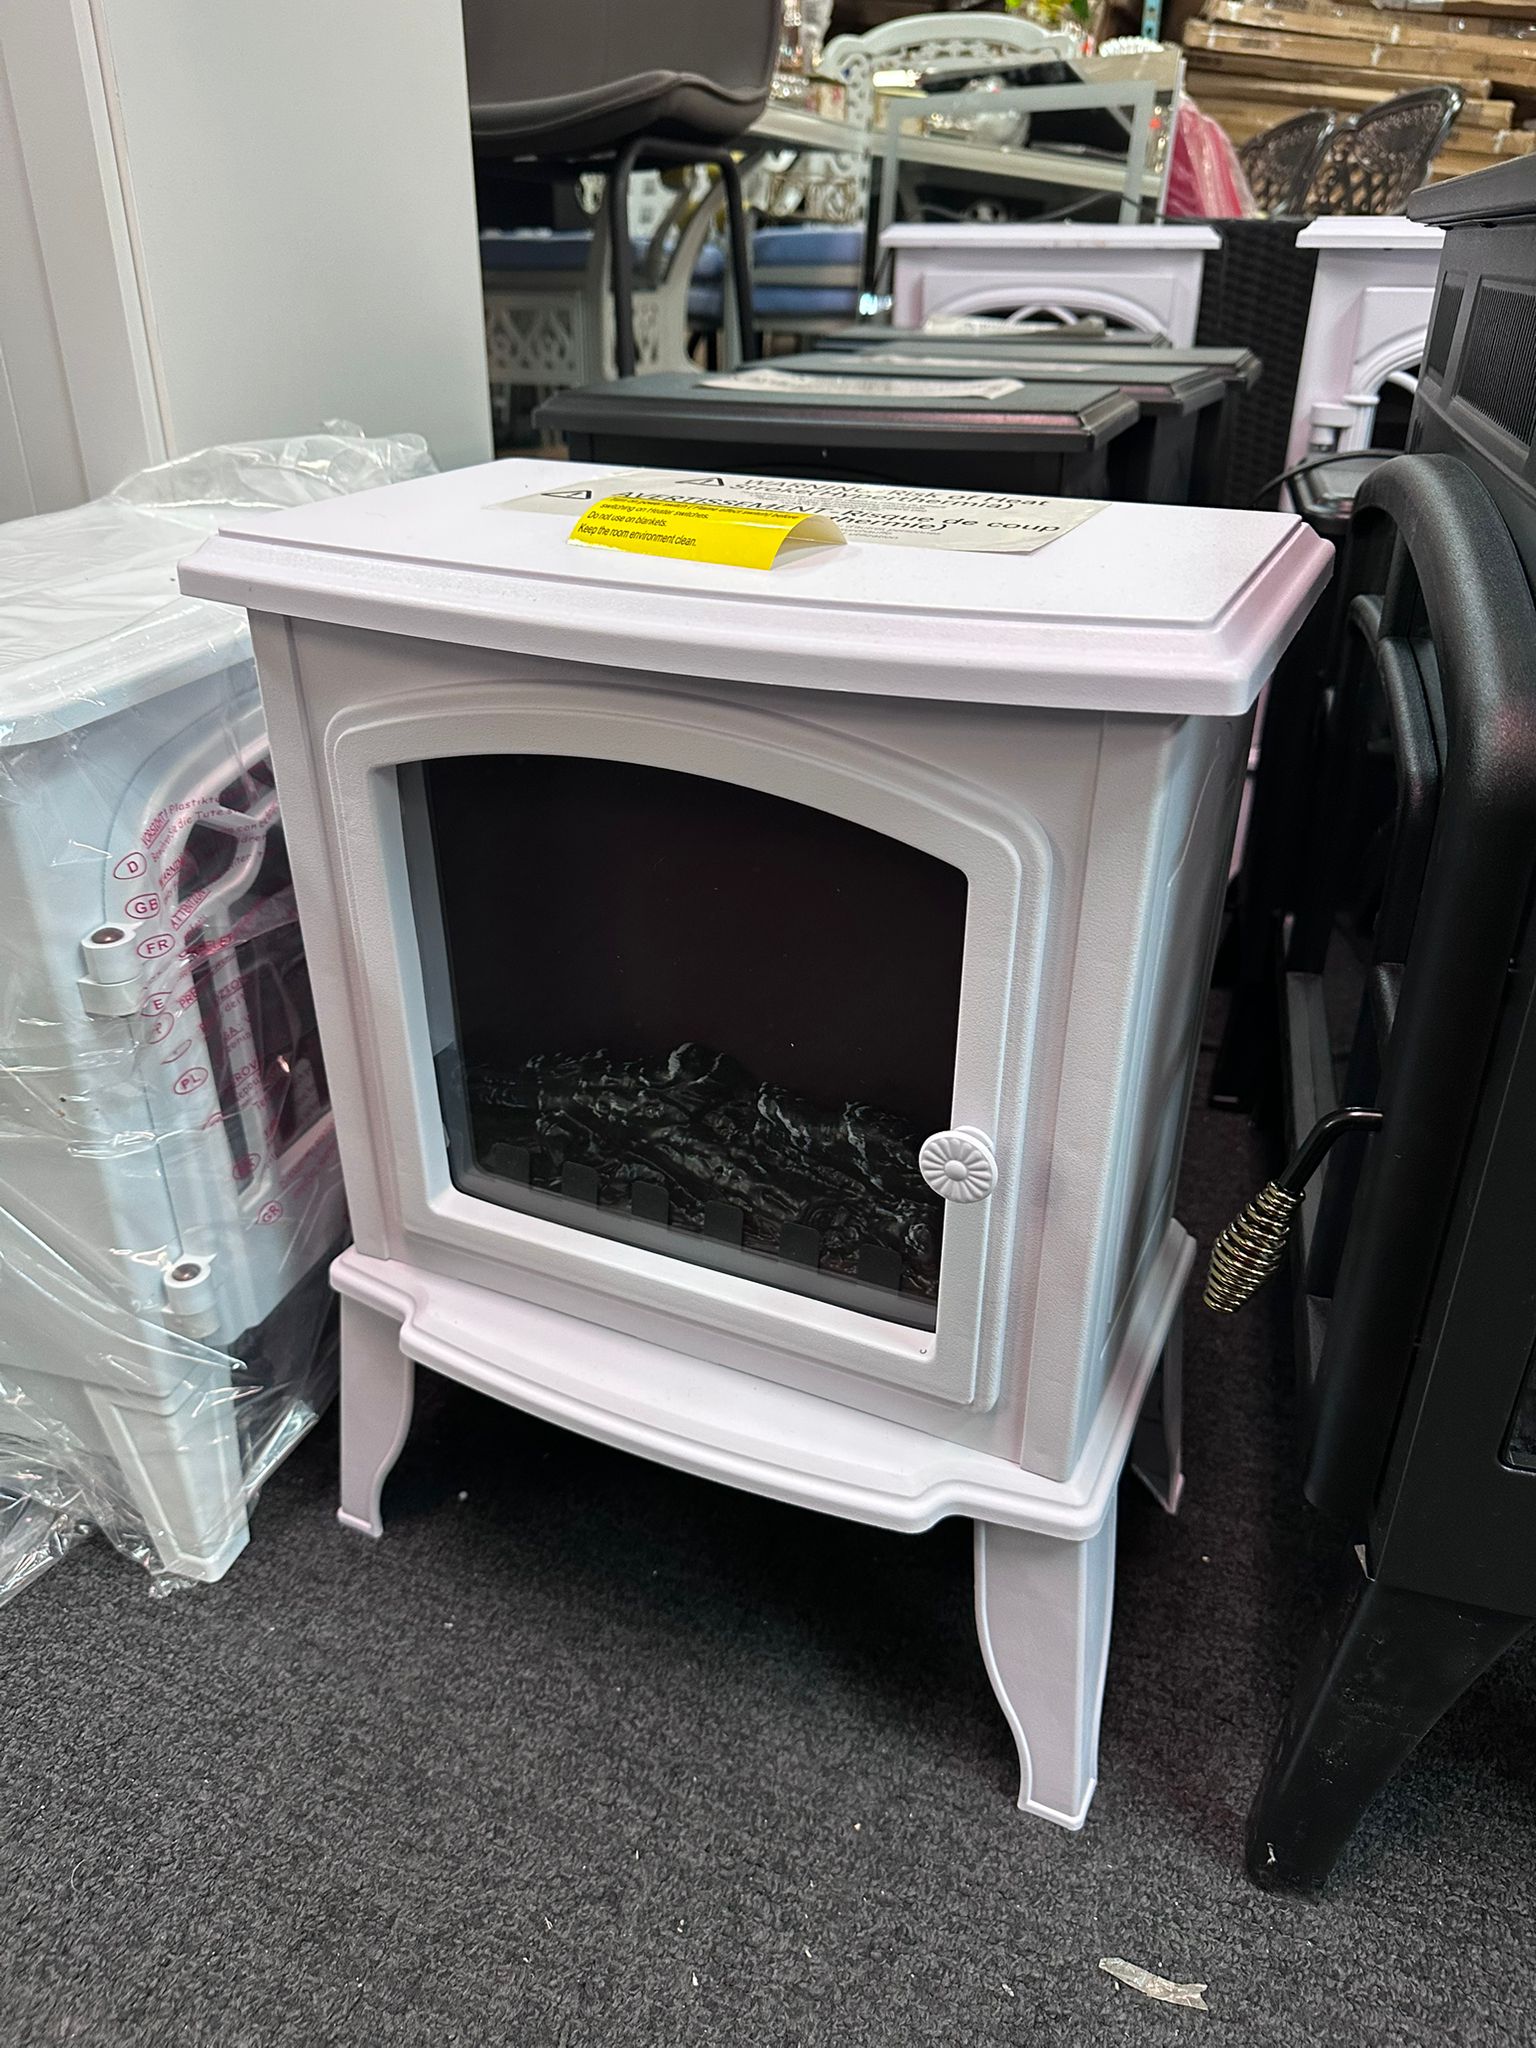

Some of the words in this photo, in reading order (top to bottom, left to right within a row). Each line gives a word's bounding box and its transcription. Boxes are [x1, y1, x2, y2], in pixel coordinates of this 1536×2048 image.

[599, 503, 636, 512] switching
[948, 494, 977, 502] of
[984, 496, 1051, 507] Heat
[587, 511, 599, 519] Do
[598, 513, 612, 521] not
[635, 516, 667, 527] blankets.
[830, 515, 948, 532] thermie)
[942, 517, 980, 526] de
[986, 522, 1061, 534] coup
[577, 523, 598, 536] Keep
[598, 526, 610, 536] the
[610, 528, 630, 538] room
[629, 531, 675, 544] environment
[675, 534, 697, 547] clean.
[135, 898, 159, 914] GB
[146, 938, 169, 954] FR
[180, 1074, 201, 1090] PL
[261, 1204, 281, 1223] GR
